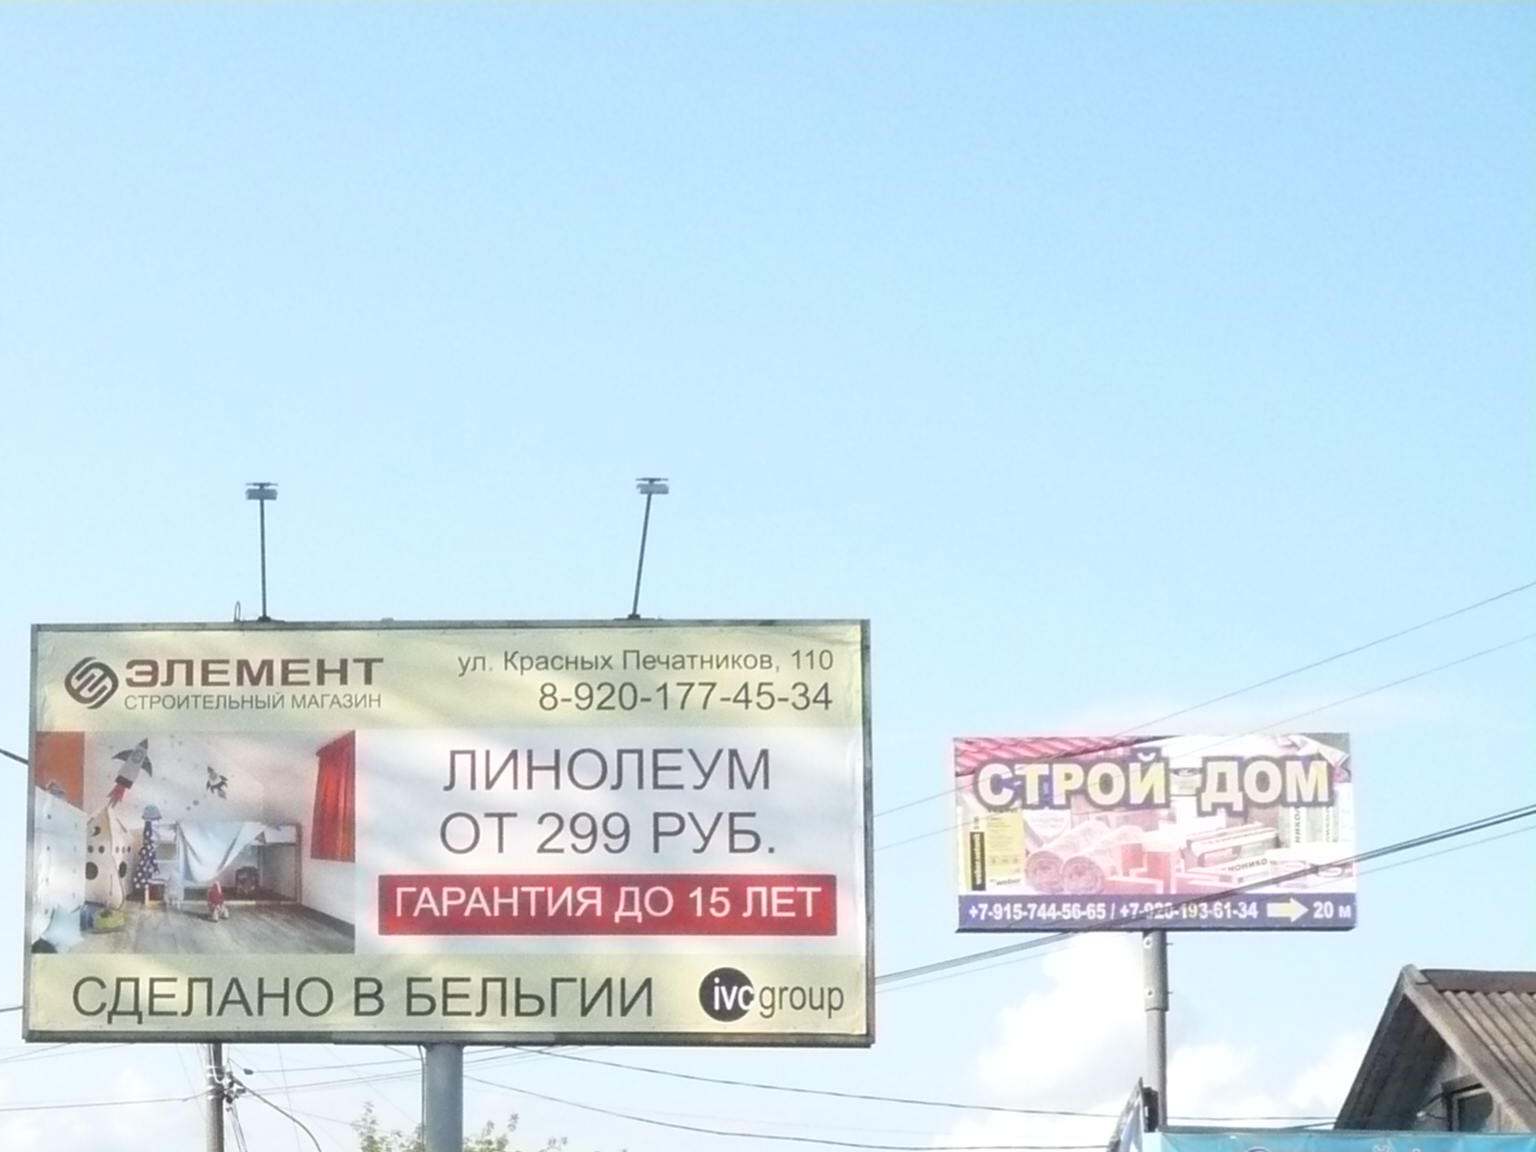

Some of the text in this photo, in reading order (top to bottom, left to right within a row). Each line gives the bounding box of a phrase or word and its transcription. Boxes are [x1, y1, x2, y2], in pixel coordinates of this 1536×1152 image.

[125, 657, 384, 688] ЭЛЕМЕНТ
[458, 649, 834, 677] ул. Красных Печатников, 110
[124, 692, 382, 710] СТРОИТЕЛЬНЫЙ МАГАЗИН
[538, 681, 834, 711] 8-920-177-45-34
[443, 747, 770, 792] ЛИНОЛЕУМ
[976, 750, 1331, 812] СТРОЙ ДОМ
[439, 811, 776, 854] ОТ 299 РУБ.
[395, 886, 822, 923] ГАРАНТИЯ ДО 15 ЛЕТ
[968, 902, 1107, 921] +7-915-744-56-65
[1312, 901, 1334, 919] 20
[72, 976, 654, 1024] СДЕЛАНО В БЕЛЬГИИ
[758, 980, 846, 1018] group
